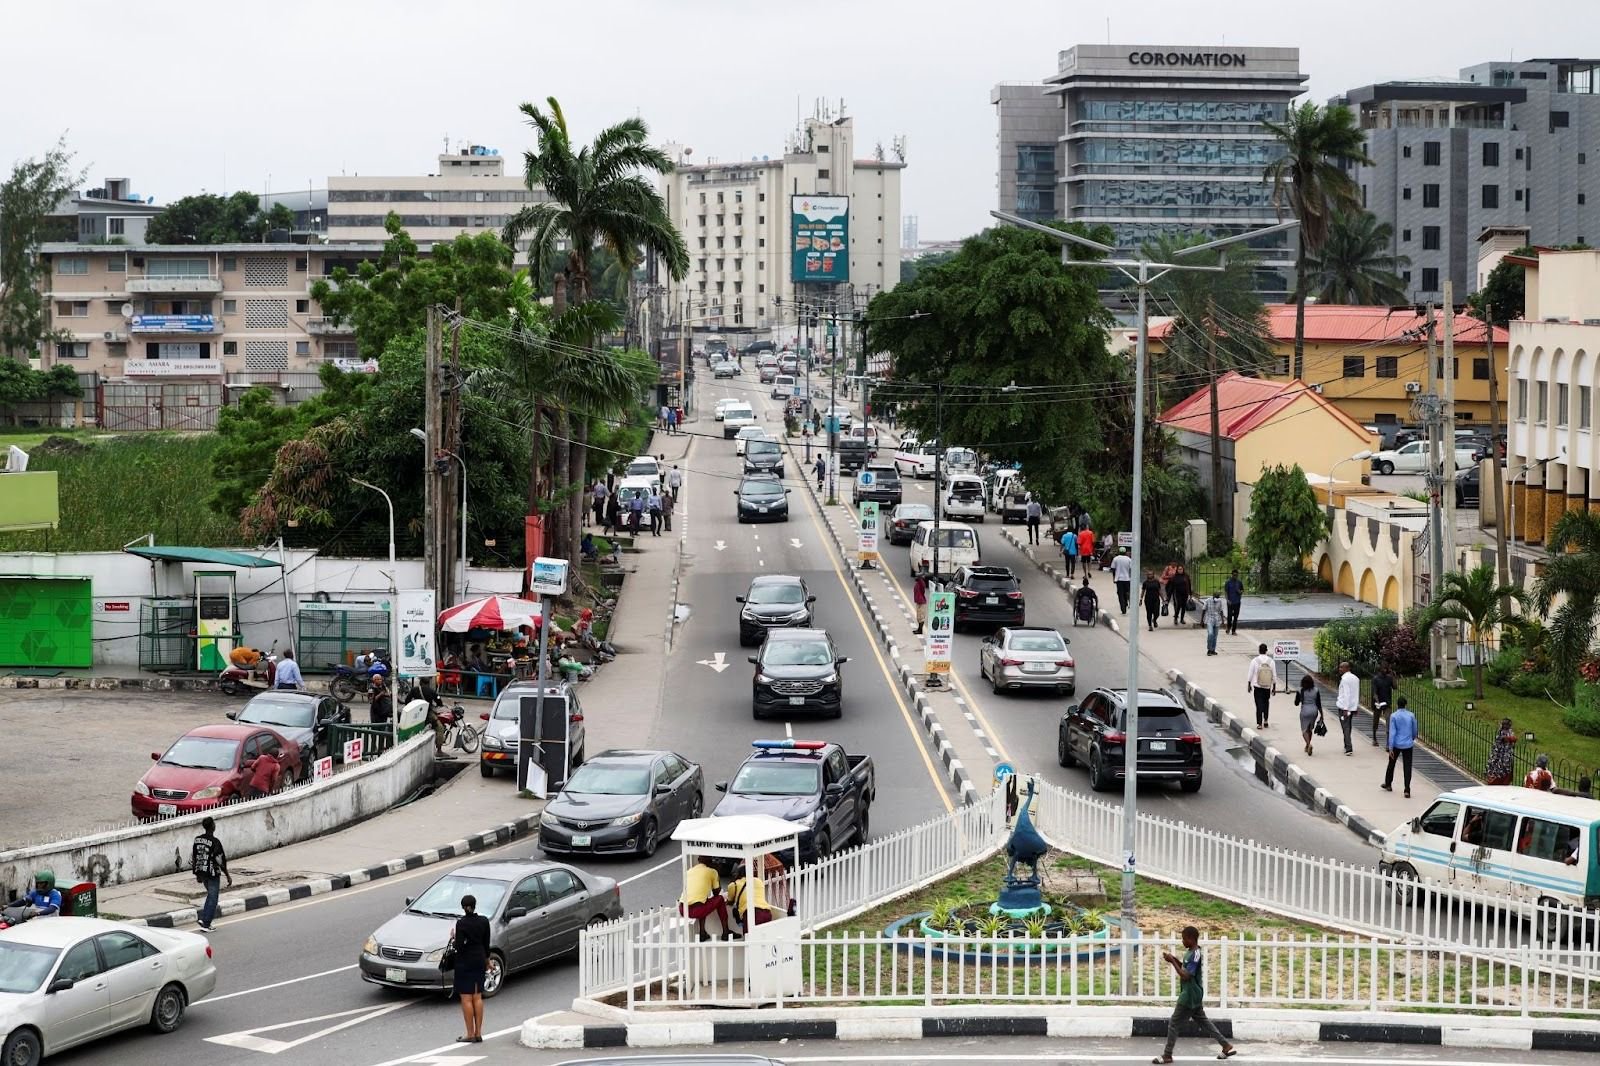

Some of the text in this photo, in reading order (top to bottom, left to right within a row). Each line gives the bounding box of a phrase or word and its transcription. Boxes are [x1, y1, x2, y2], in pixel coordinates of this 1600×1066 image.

[1128, 51, 1246, 67] CORONATION
[687, 840, 744, 850] TRAFFIC OFFICER
[753, 839, 775, 849] TRAFFIC
